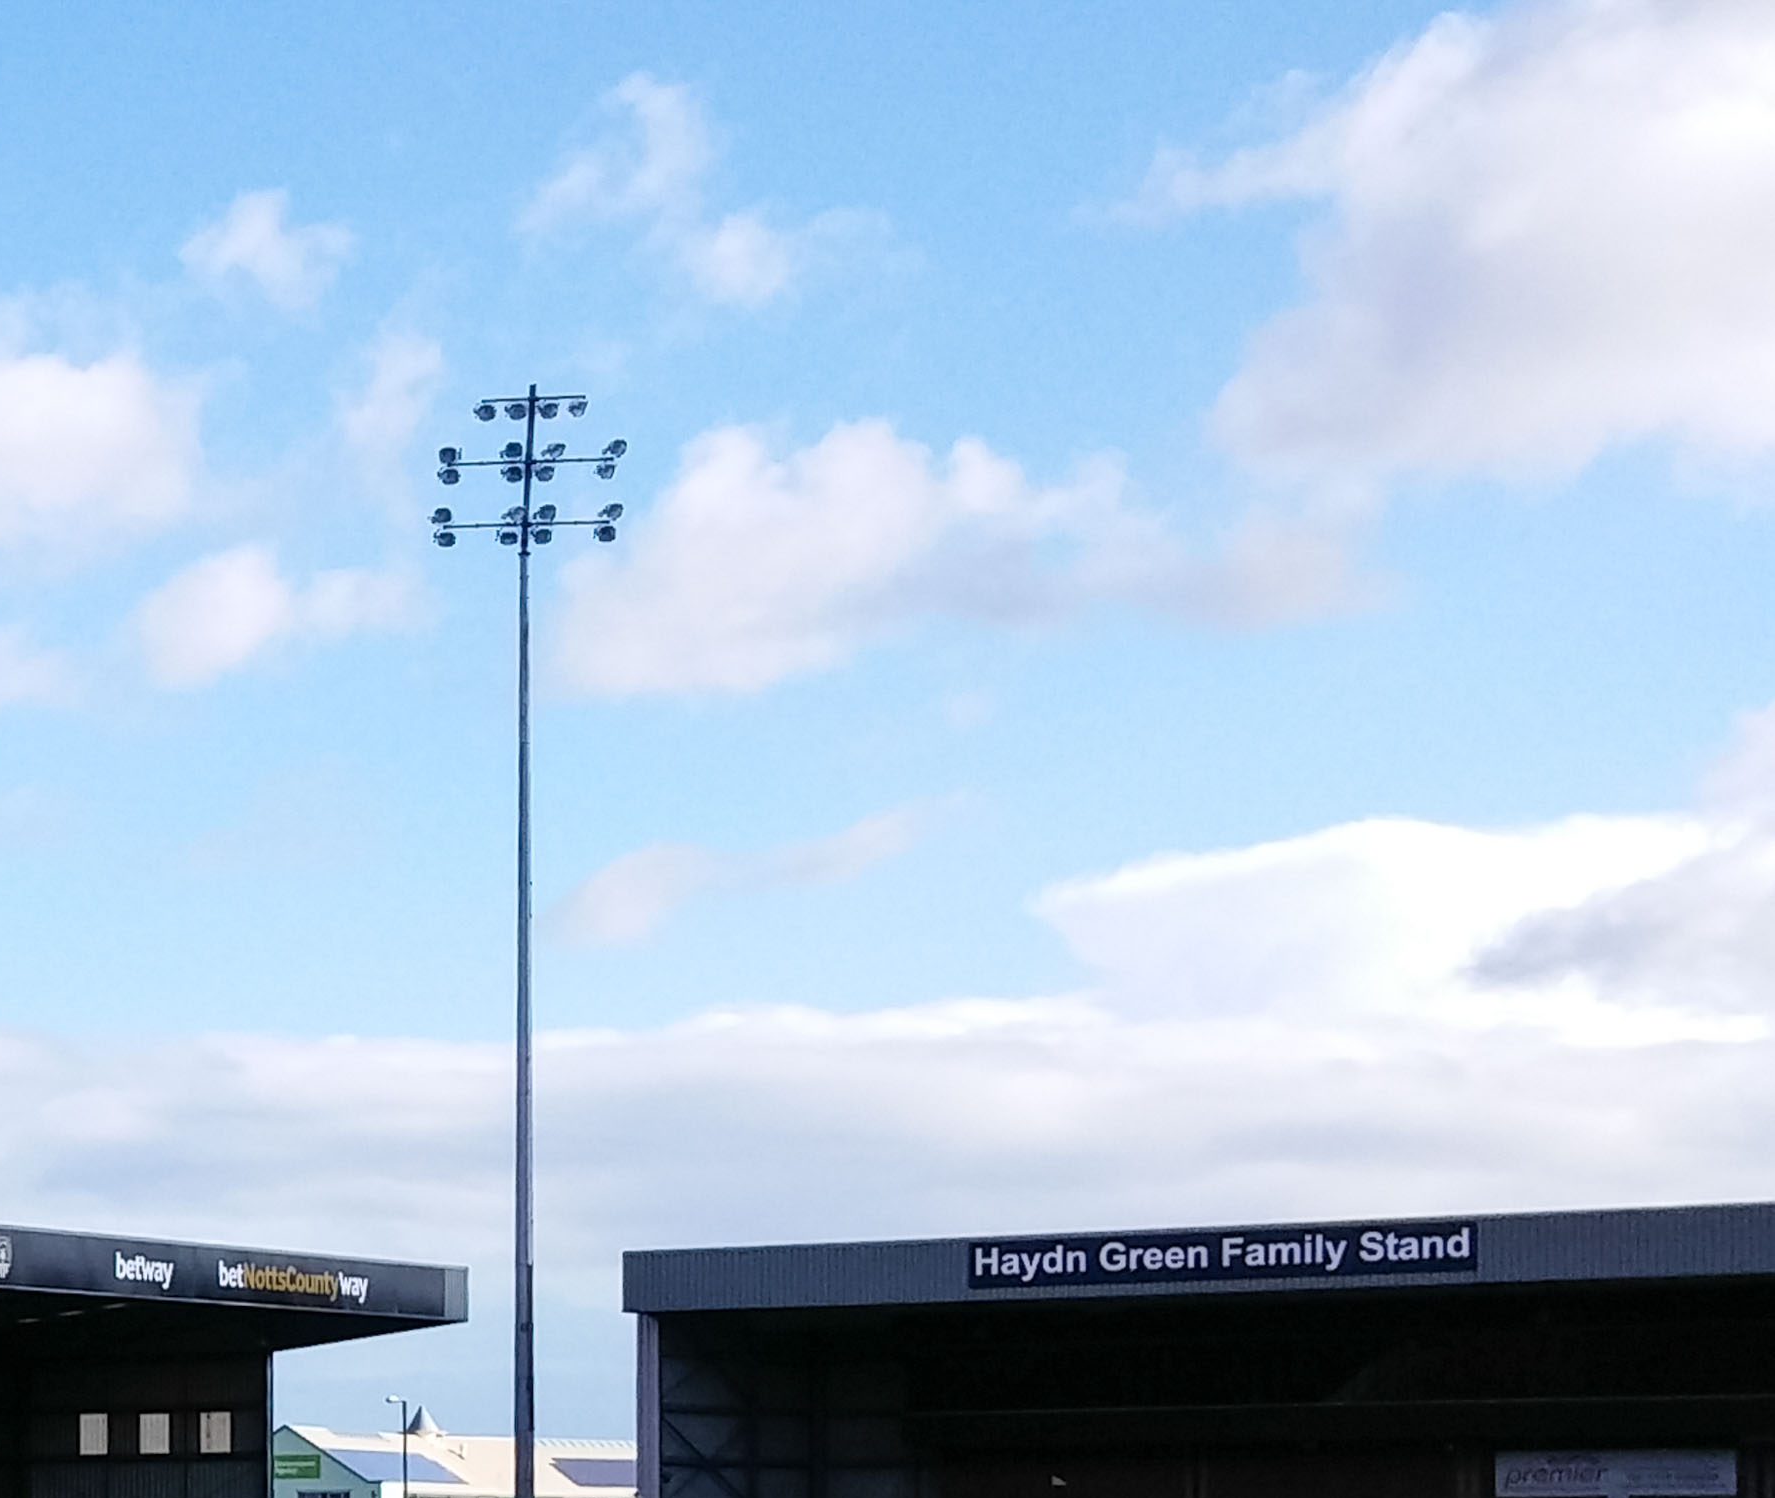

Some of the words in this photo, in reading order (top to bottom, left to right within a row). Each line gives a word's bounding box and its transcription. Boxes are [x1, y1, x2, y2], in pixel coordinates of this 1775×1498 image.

[115, 1251, 173, 1290] betway
[974, 1245, 1087, 1282] Haydn
[1098, 1241, 1209, 1273] Green
[1221, 1234, 1347, 1271] Family
[1358, 1228, 1471, 1262] Stand
[218, 1260, 368, 1303] betNottsCountyway
